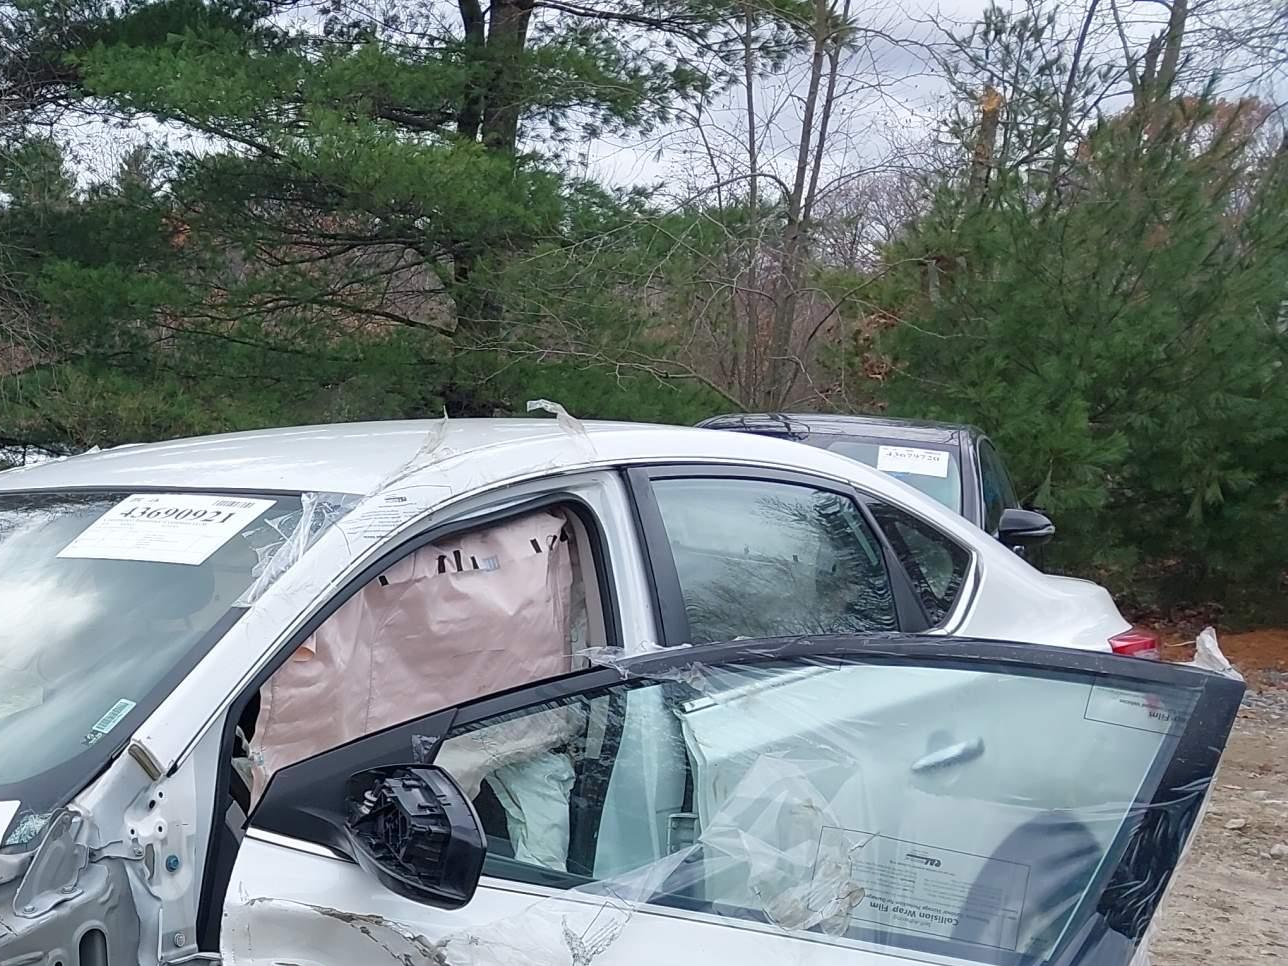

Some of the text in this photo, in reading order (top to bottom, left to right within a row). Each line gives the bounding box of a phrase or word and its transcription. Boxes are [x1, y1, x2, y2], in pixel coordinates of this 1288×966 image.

[120, 506, 236, 523] 43690921
[869, 901, 889, 912] Film
[892, 905, 917, 918] Wrap
[918, 912, 959, 926] Collision
